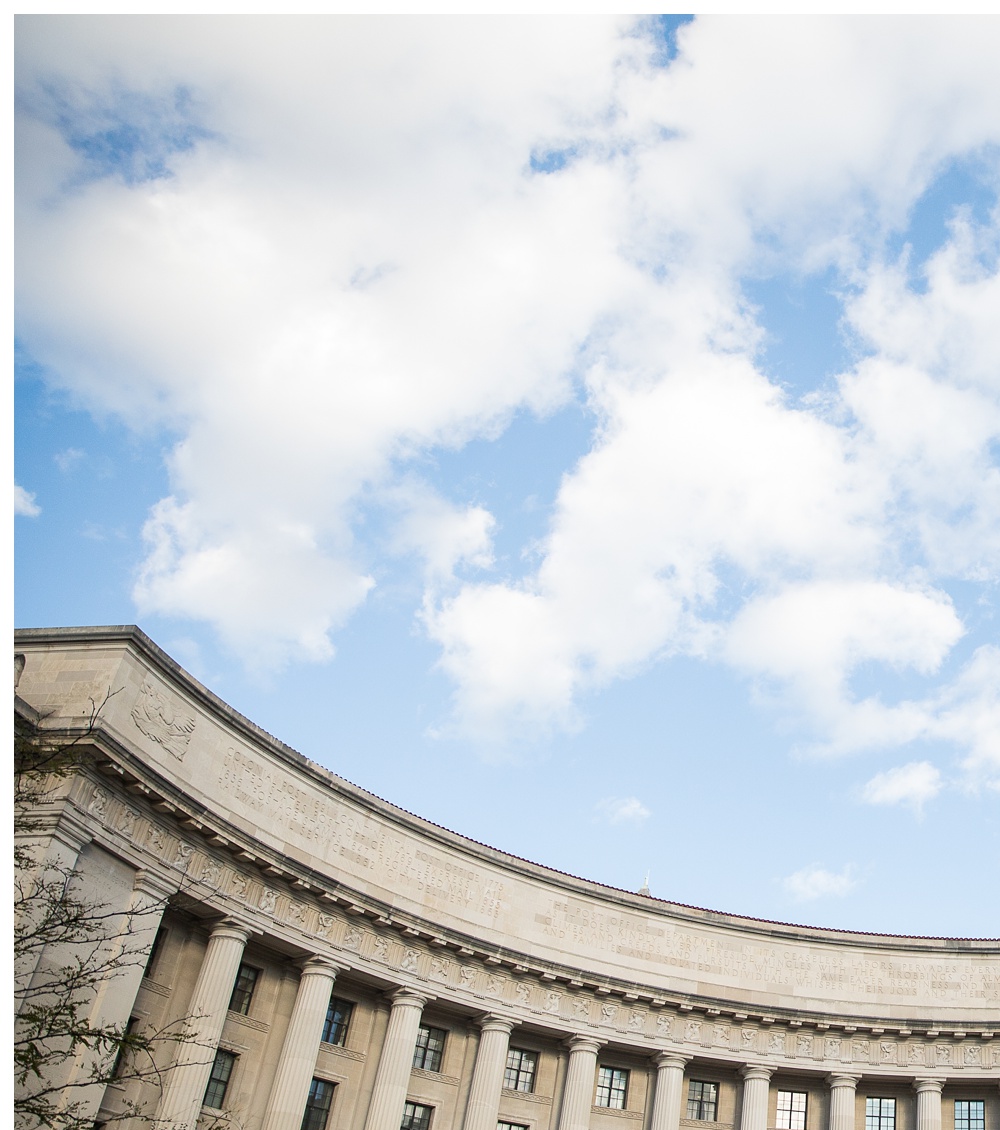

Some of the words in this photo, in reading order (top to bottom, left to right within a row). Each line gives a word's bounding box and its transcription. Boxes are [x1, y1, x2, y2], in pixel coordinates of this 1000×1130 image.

[542, 925, 564, 938] AND
[573, 934, 620, 952] FAMILIES
[630, 949, 650, 959] AND
[660, 955, 710, 972] ISOLATED
[718, 967, 788, 984] INDIVIDUALS
[796, 978, 842, 990] WHISPER
[852, 985, 882, 994] THEIR
[890, 987, 917, 996] JOYS
[926, 989, 946, 997] AND
[576, 908, 602, 921] POST
[610, 917, 648, 932] OFFICE
[657, 928, 730, 949] DEPARTMENT
[783, 951, 842, 964] CEASELESS
[852, 959, 892, 969] LABORS
[902, 963, 956, 972] PERVADES
[583, 919, 609, 932] DOES
[618, 928, 656, 943] KINDLY
[666, 939, 698, 952] EVERY
[706, 947, 753, 962] FIRESIDE
[762, 957, 810, 970] MINGLES
[818, 964, 845, 974] WITH
[854, 968, 872, 976] THE
[881, 970, 952, 980] THROBBINGS
[669, 948, 689, 959] AND
[815, 972, 842, 981] SAME
[850, 976, 882, 985] EAGER
[890, 979, 948, 989] READINESS
[954, 982, 976, 990] AND
